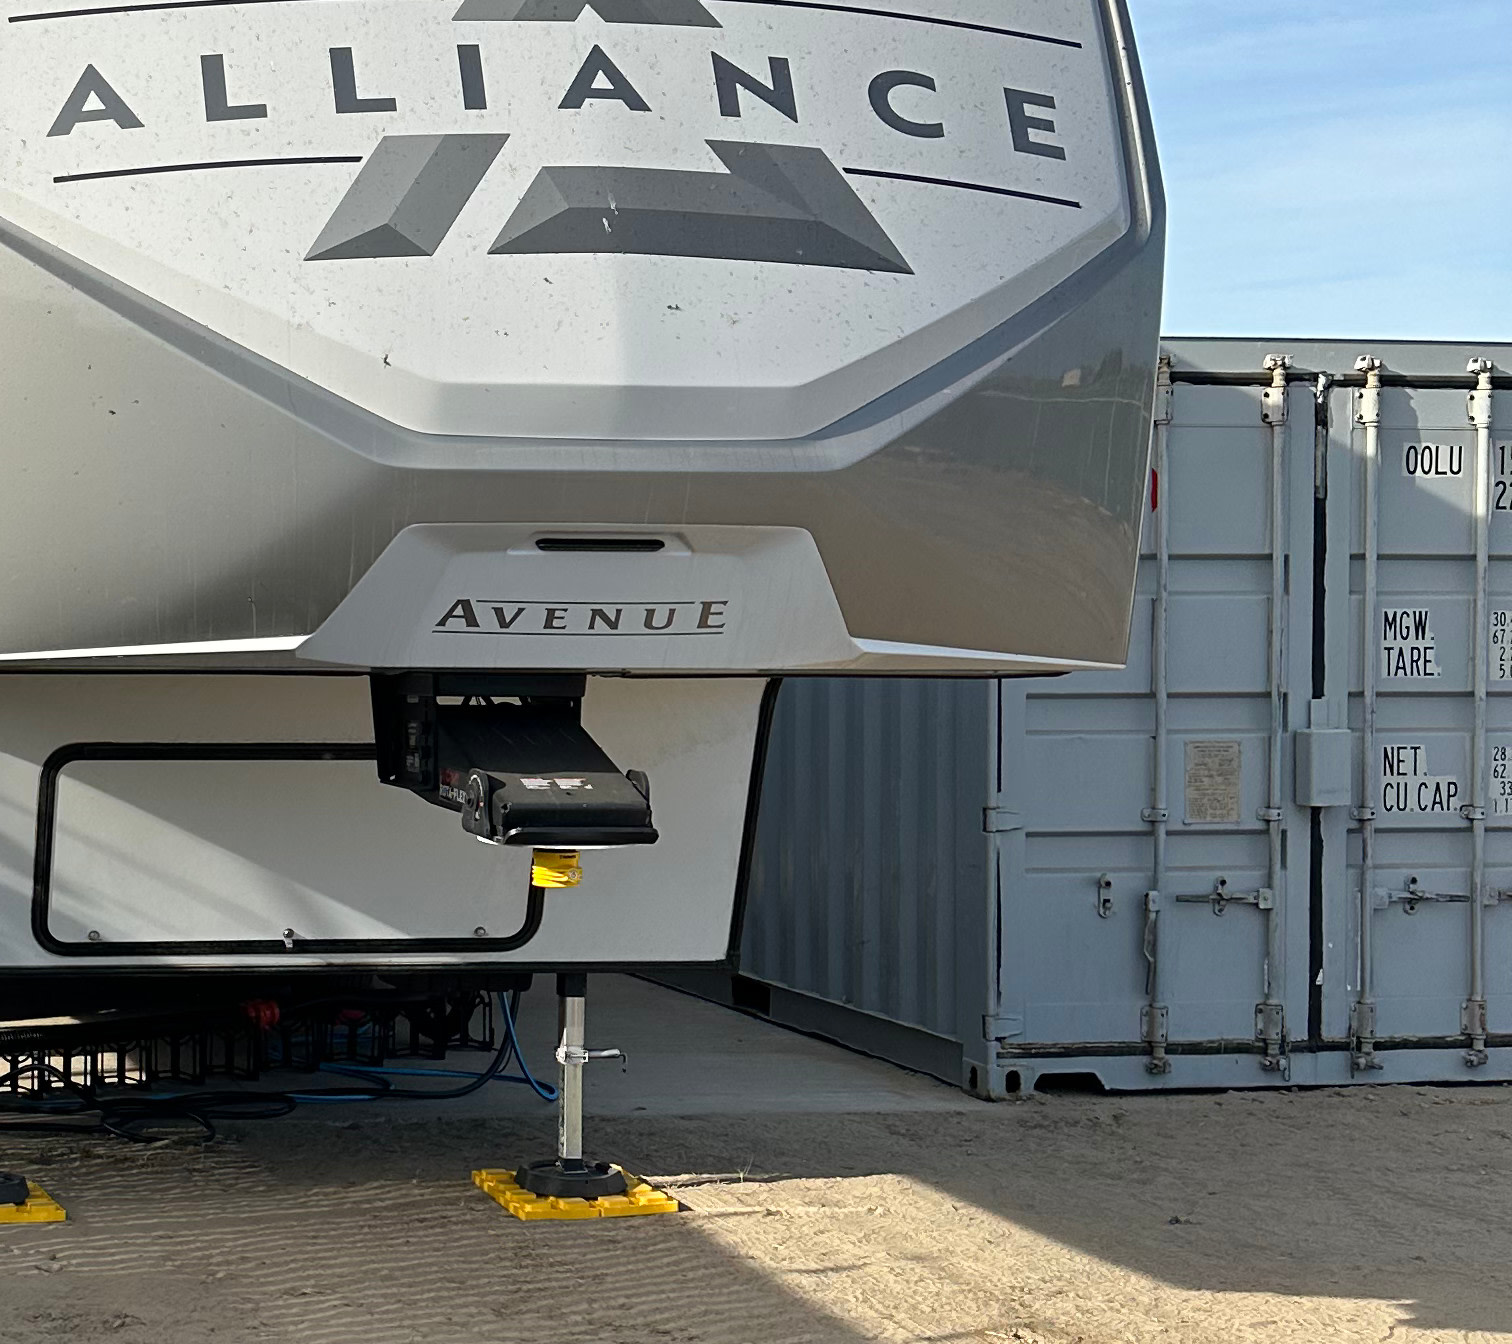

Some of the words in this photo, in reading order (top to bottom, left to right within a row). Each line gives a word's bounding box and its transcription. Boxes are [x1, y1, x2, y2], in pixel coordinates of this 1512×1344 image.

[46, 42, 1068, 161] ALLIANCE
[1499, 445, 1512, 476] 1
[1495, 480, 1512, 511] 2
[434, 598, 730, 631] AVENUE
[1383, 610, 1435, 641] MGW.
[1383, 646, 1441, 677] TARE.
[1383, 746, 1428, 777] NET.
